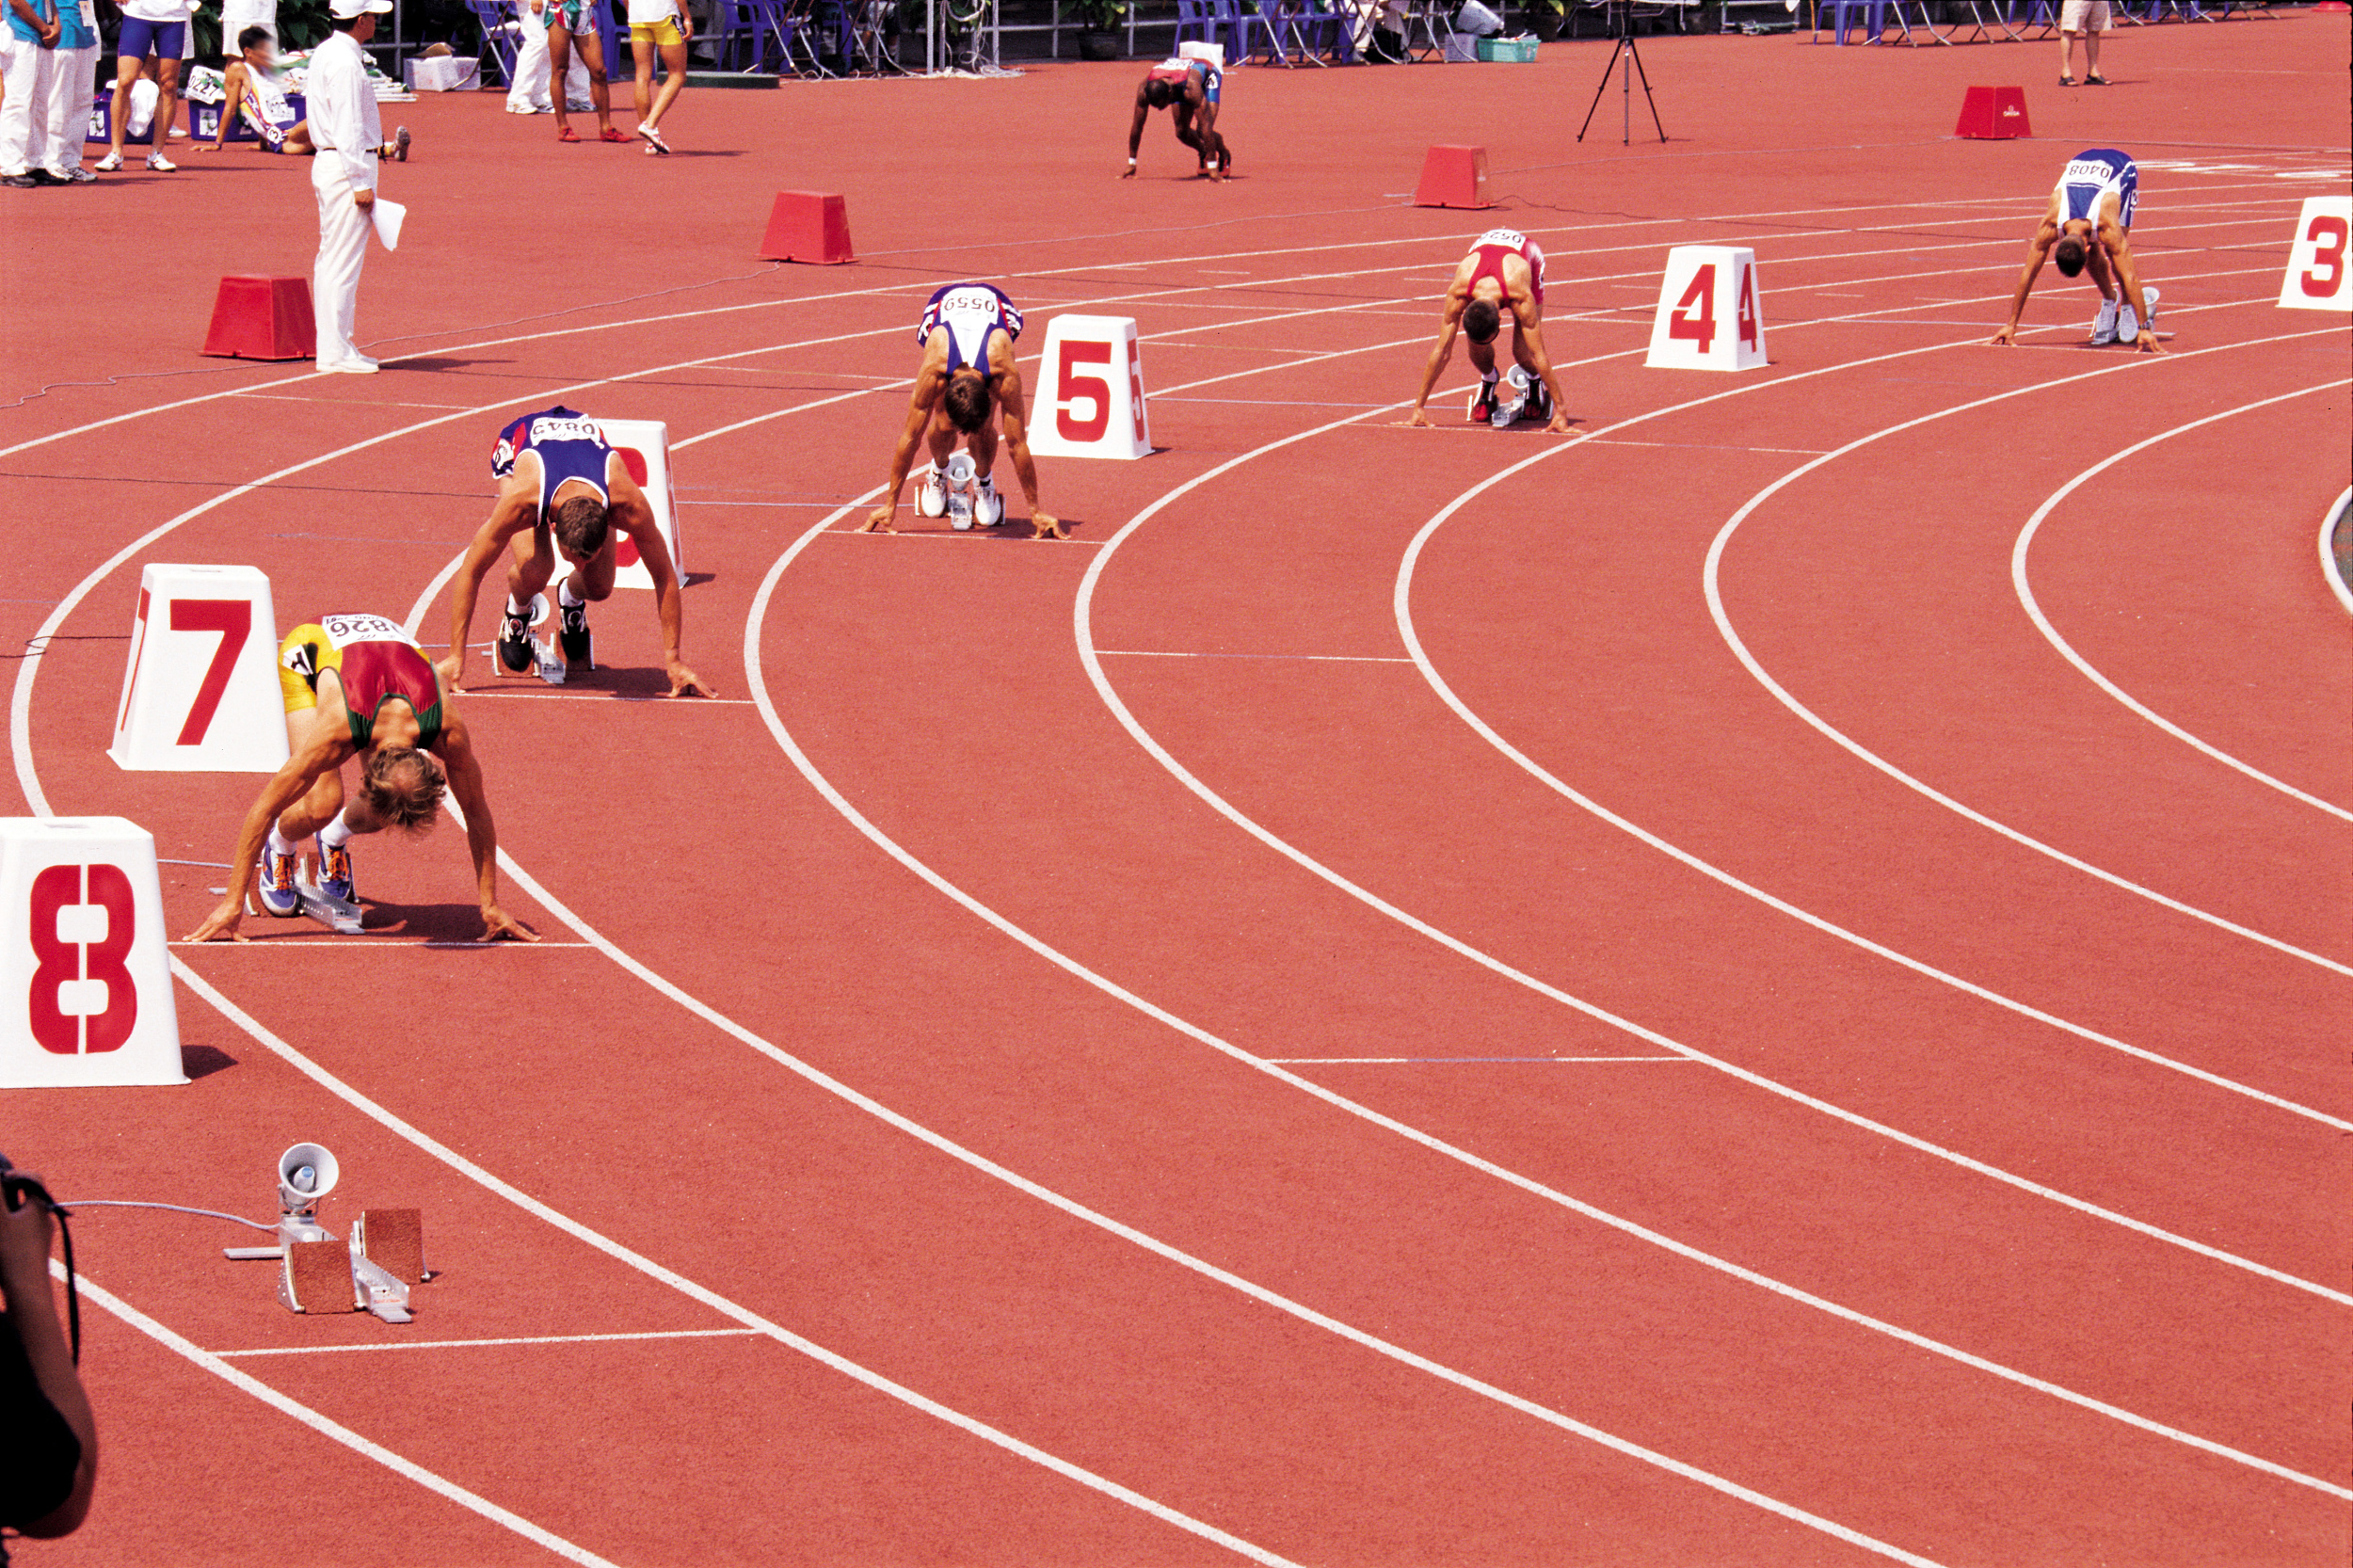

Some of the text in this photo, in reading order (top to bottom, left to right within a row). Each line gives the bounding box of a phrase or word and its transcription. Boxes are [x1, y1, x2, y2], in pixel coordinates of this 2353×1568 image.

[2069, 165, 2110, 179] 0408
[2300, 215, 2349, 298] 3
[944, 296, 996, 312] 0559
[1669, 264, 1717, 354] 4
[1737, 263, 1757, 353] 4
[1056, 339, 1112, 443] 5
[169, 599, 252, 746] 7
[28, 863, 138, 1055] 8
